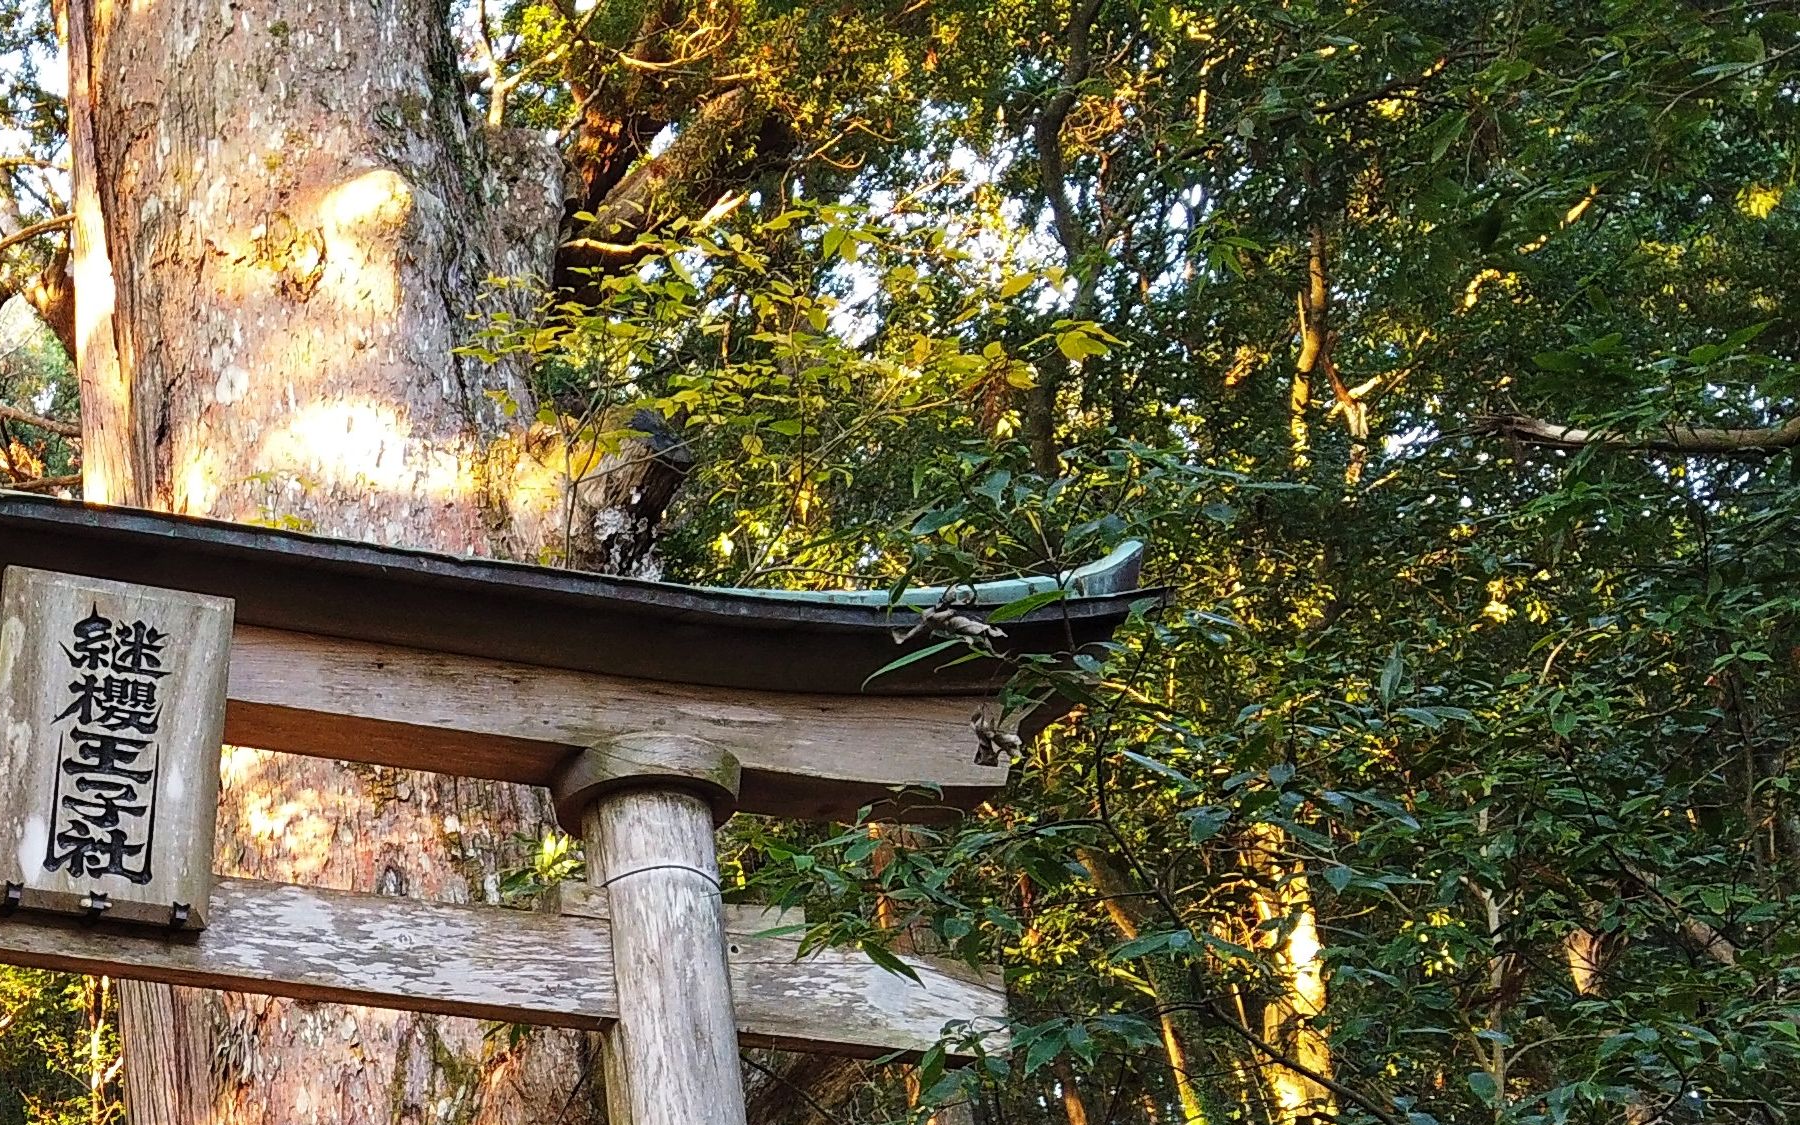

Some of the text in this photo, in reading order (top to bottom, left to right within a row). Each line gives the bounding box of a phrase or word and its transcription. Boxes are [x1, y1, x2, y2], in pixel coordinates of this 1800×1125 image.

[42, 600, 172, 885] 継櫻王子社
